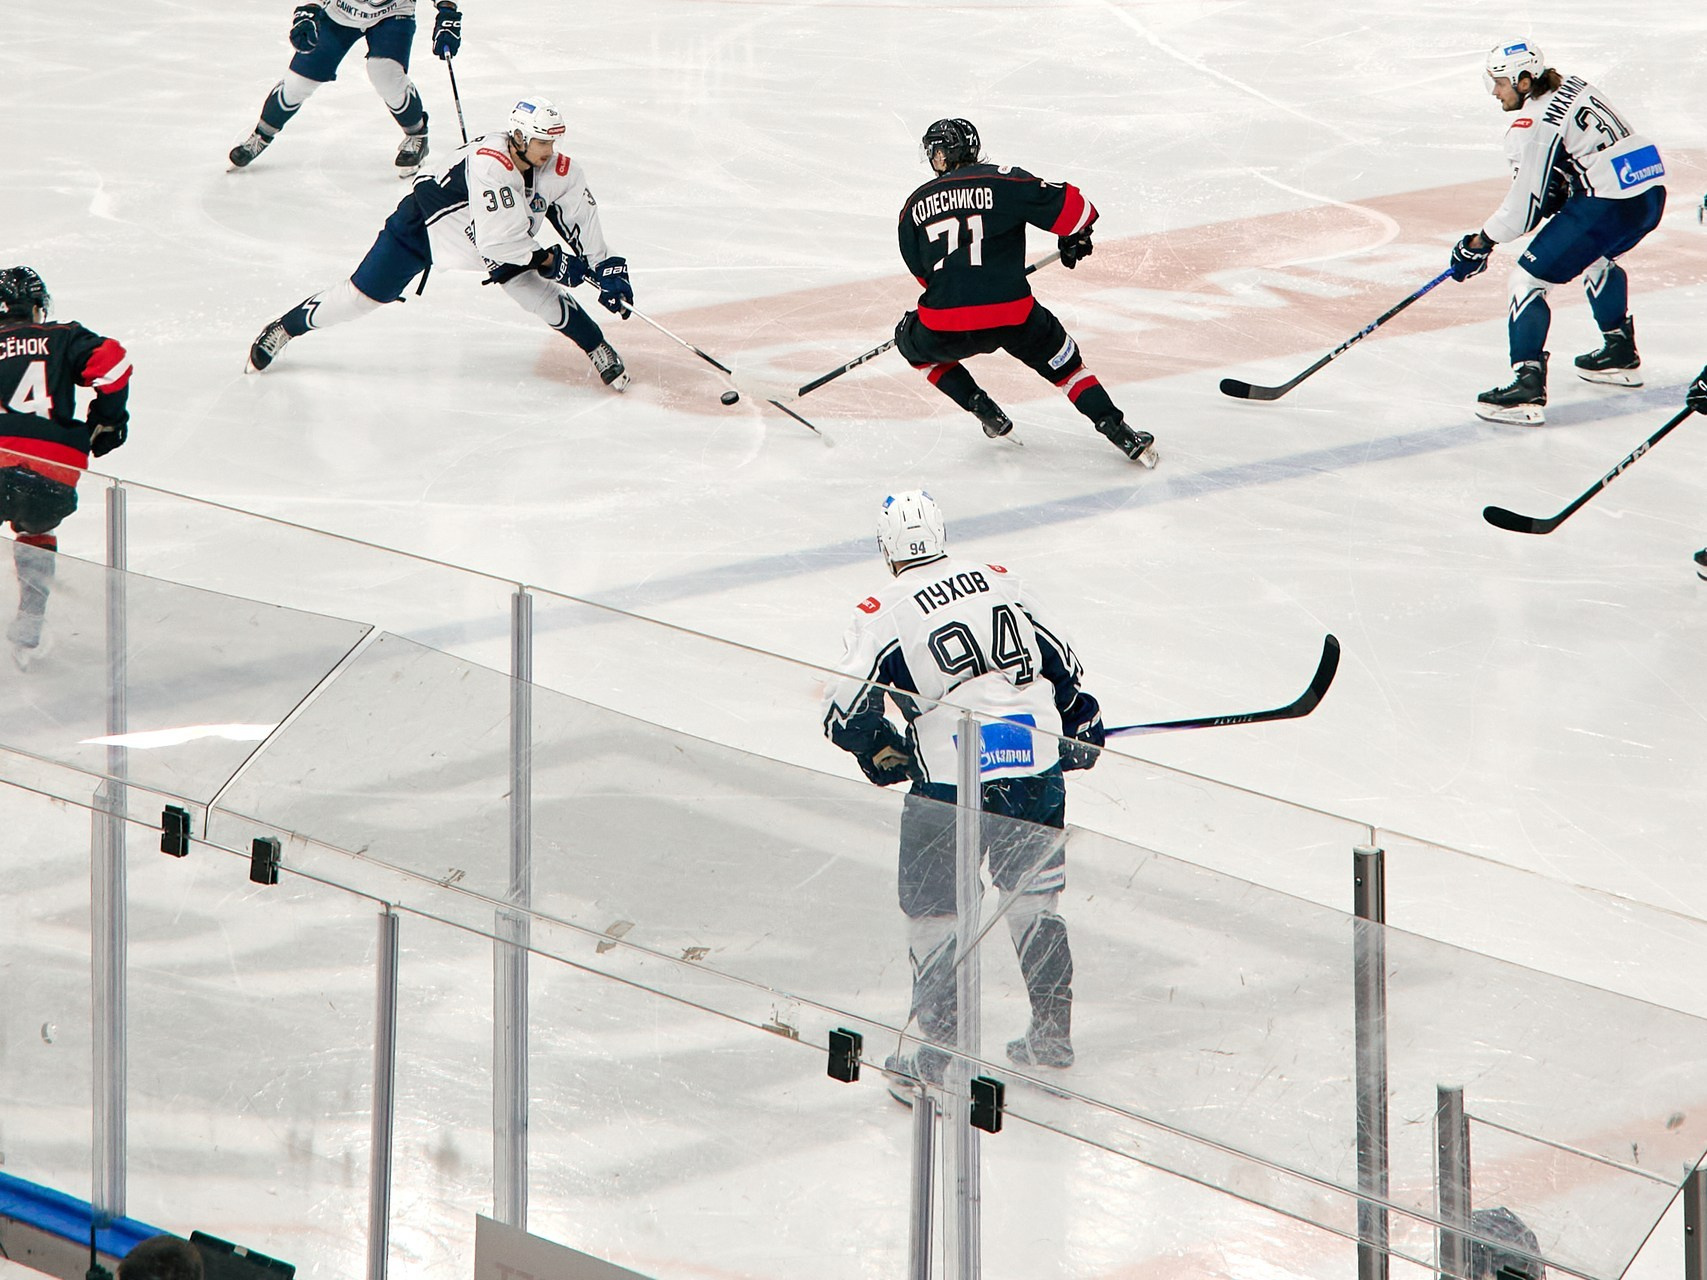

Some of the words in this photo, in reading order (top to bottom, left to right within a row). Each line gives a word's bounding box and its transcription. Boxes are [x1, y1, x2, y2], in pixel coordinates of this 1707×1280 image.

[1574, 95, 1631, 152] 31
[483, 186, 515, 212] 38
[911, 187, 994, 227] КОЛЕСНИКОВ
[925, 214, 984, 271] 71
[909, 540, 927, 556] 94
[913, 571, 990, 615] ПУХОВ
[928, 604, 1034, 692] 94
